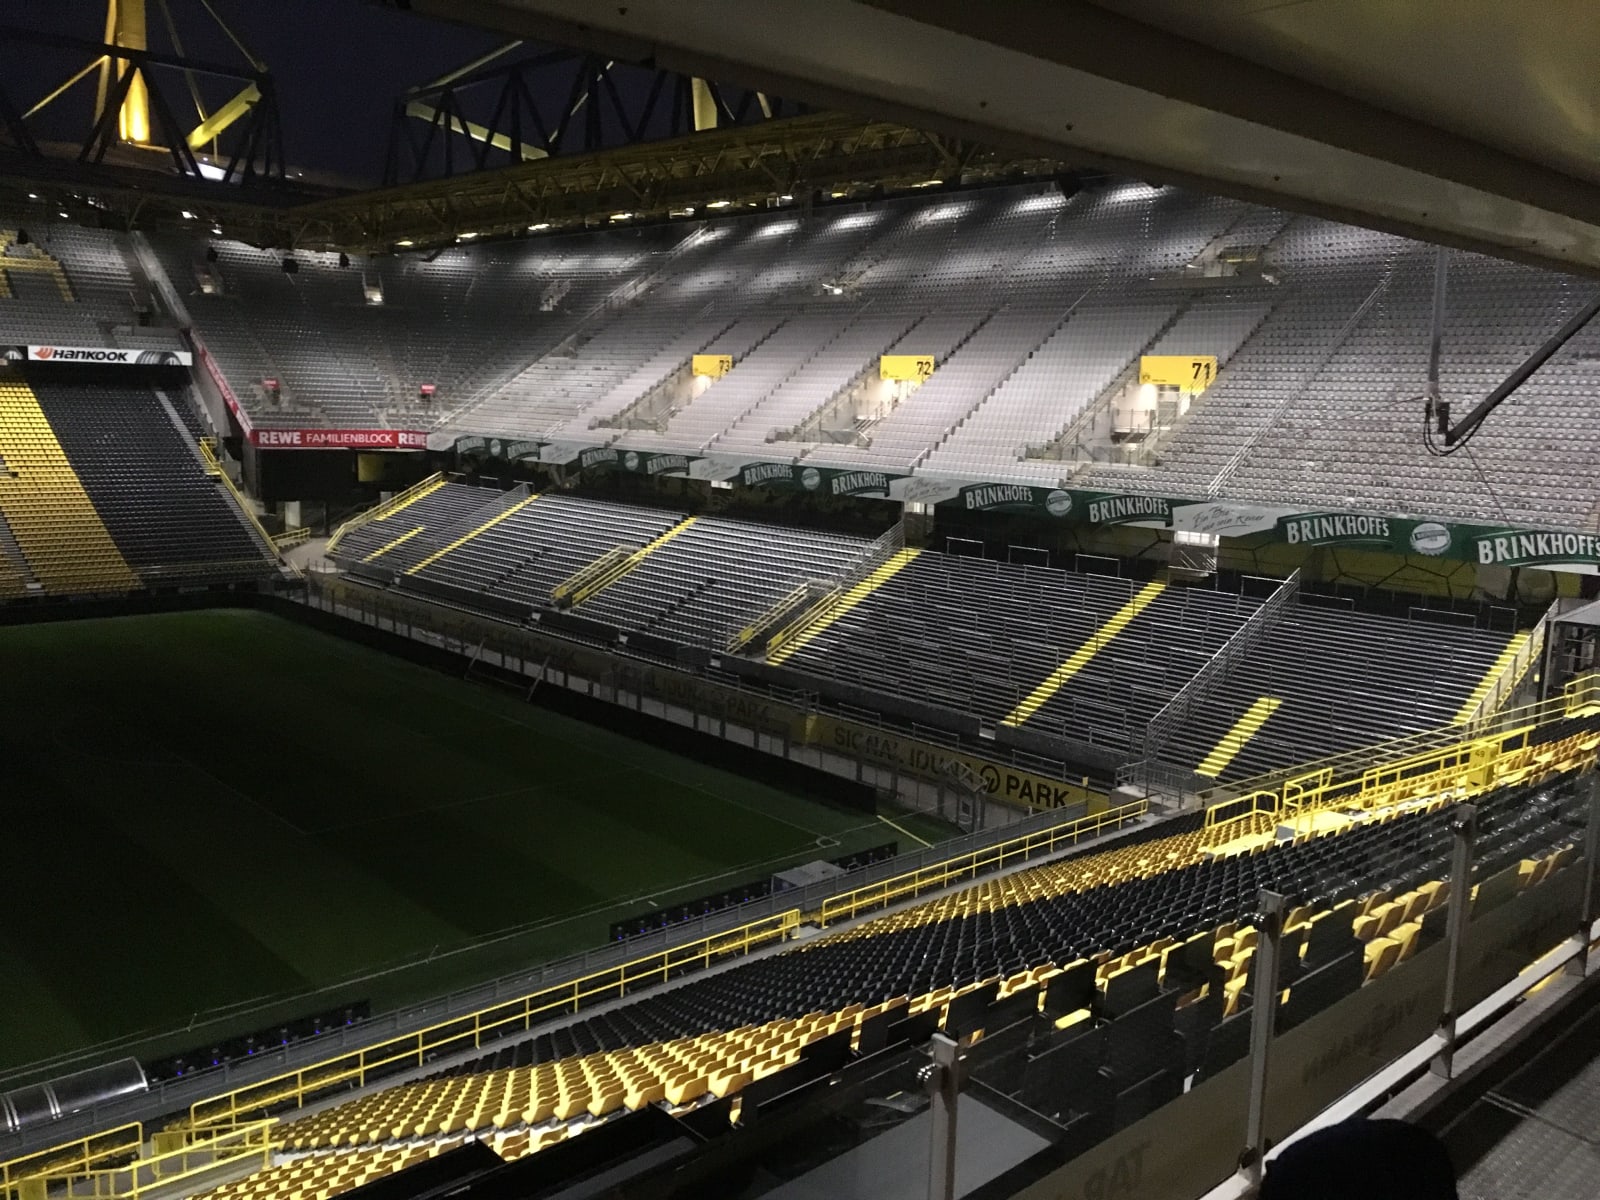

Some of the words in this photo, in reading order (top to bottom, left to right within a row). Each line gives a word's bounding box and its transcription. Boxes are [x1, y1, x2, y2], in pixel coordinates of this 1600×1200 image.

[719, 359, 730, 372] 73
[916, 361, 931, 375] 72
[1192, 362, 1211, 379] 71
[259, 431, 302, 444] REWE
[306, 433, 393, 443] FAMILIENBLOCK
[398, 432, 427, 445] REWE
[1005, 774, 1070, 809] PARK
